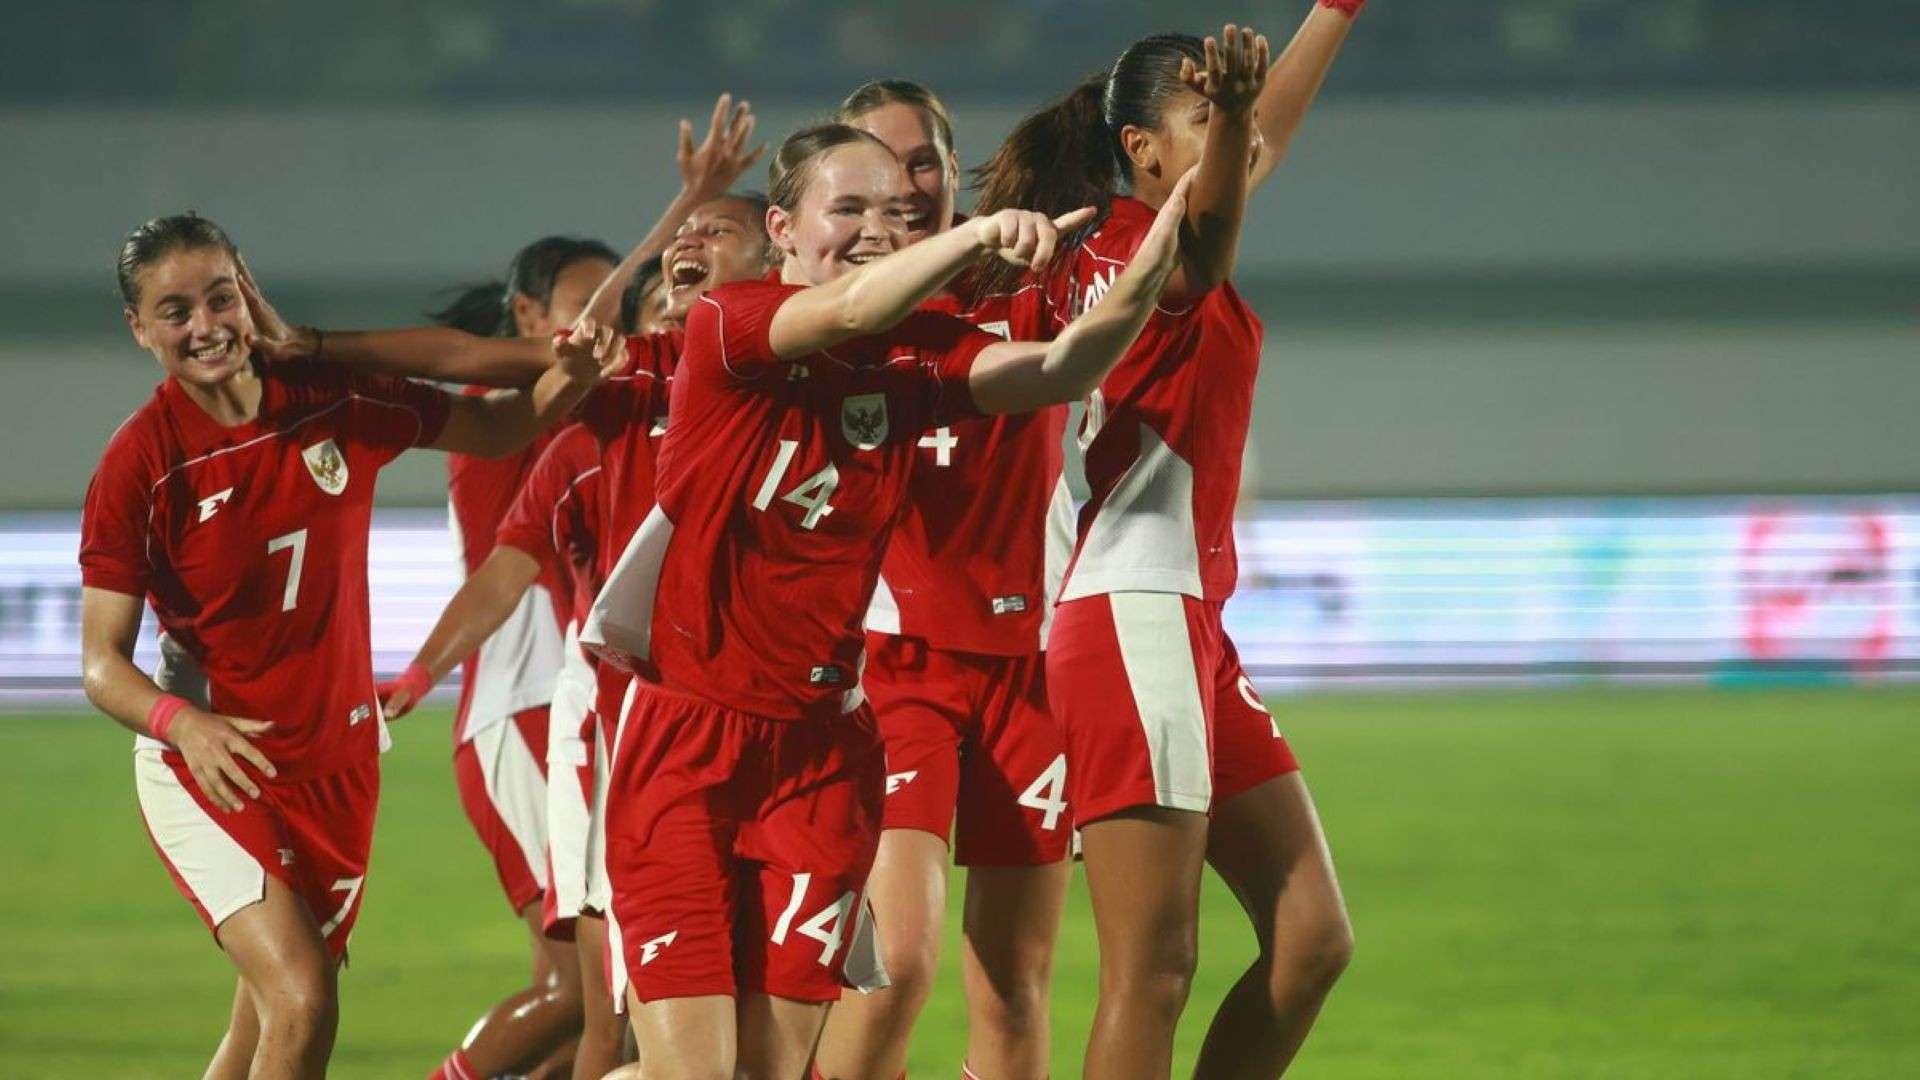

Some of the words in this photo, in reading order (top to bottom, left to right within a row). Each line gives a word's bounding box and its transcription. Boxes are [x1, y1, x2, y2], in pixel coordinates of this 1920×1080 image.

[753, 440, 838, 530] 14
[268, 529, 307, 612] 7
[1017, 753, 1067, 830] 4
[320, 873, 364, 938] 7
[771, 873, 856, 967] 14
